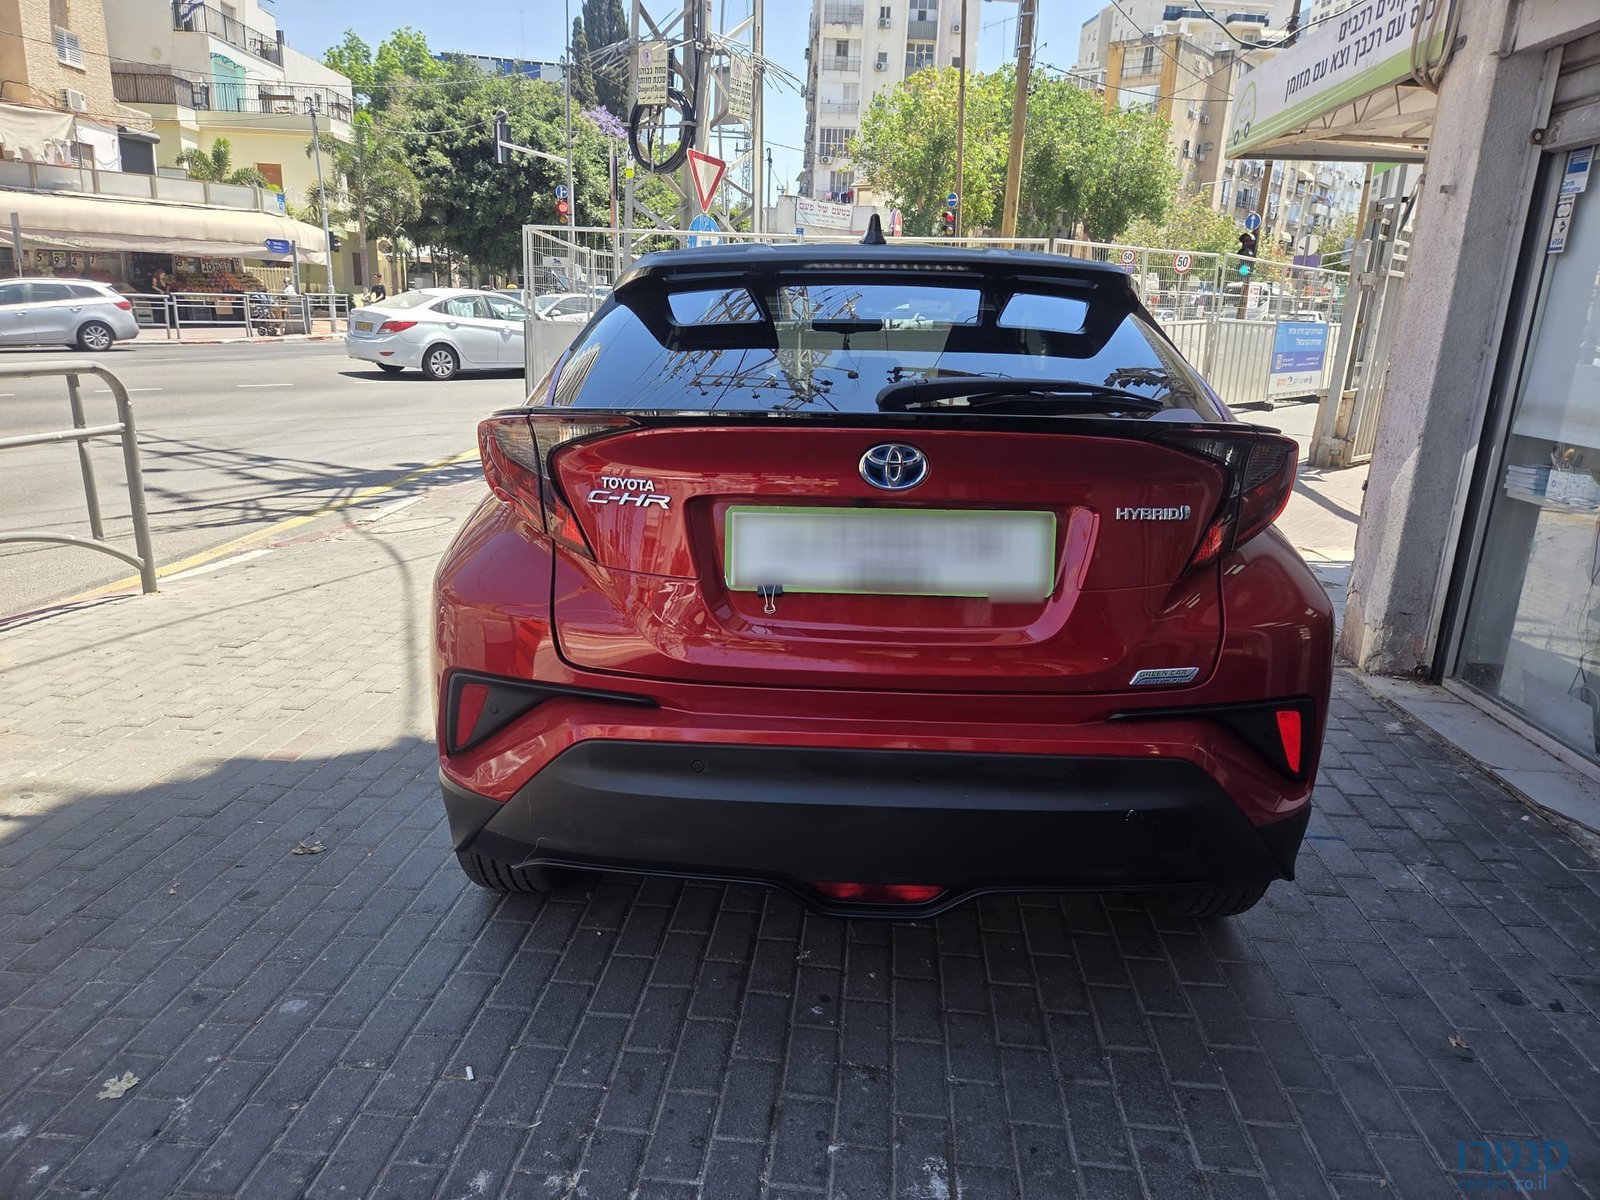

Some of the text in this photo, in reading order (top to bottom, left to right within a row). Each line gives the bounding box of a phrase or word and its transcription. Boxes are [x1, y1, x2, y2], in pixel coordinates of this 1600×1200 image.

[1339, 5, 1373, 43] רכבים
[1385, 12, 1406, 43] עם
[1354, 27, 1382, 66] רכבך
[1312, 57, 1329, 82] עם
[1330, 44, 1351, 74] וצא
[1284, 67, 1311, 103] מזומן
[1552, 238, 1564, 246] VISA
[1123, 252, 1133, 261] 50
[1177, 256, 1189, 268] 50
[601, 476, 655, 492] TOYOTA
[587, 490, 671, 510] C-HR
[1116, 507, 1180, 521] HYBRID
